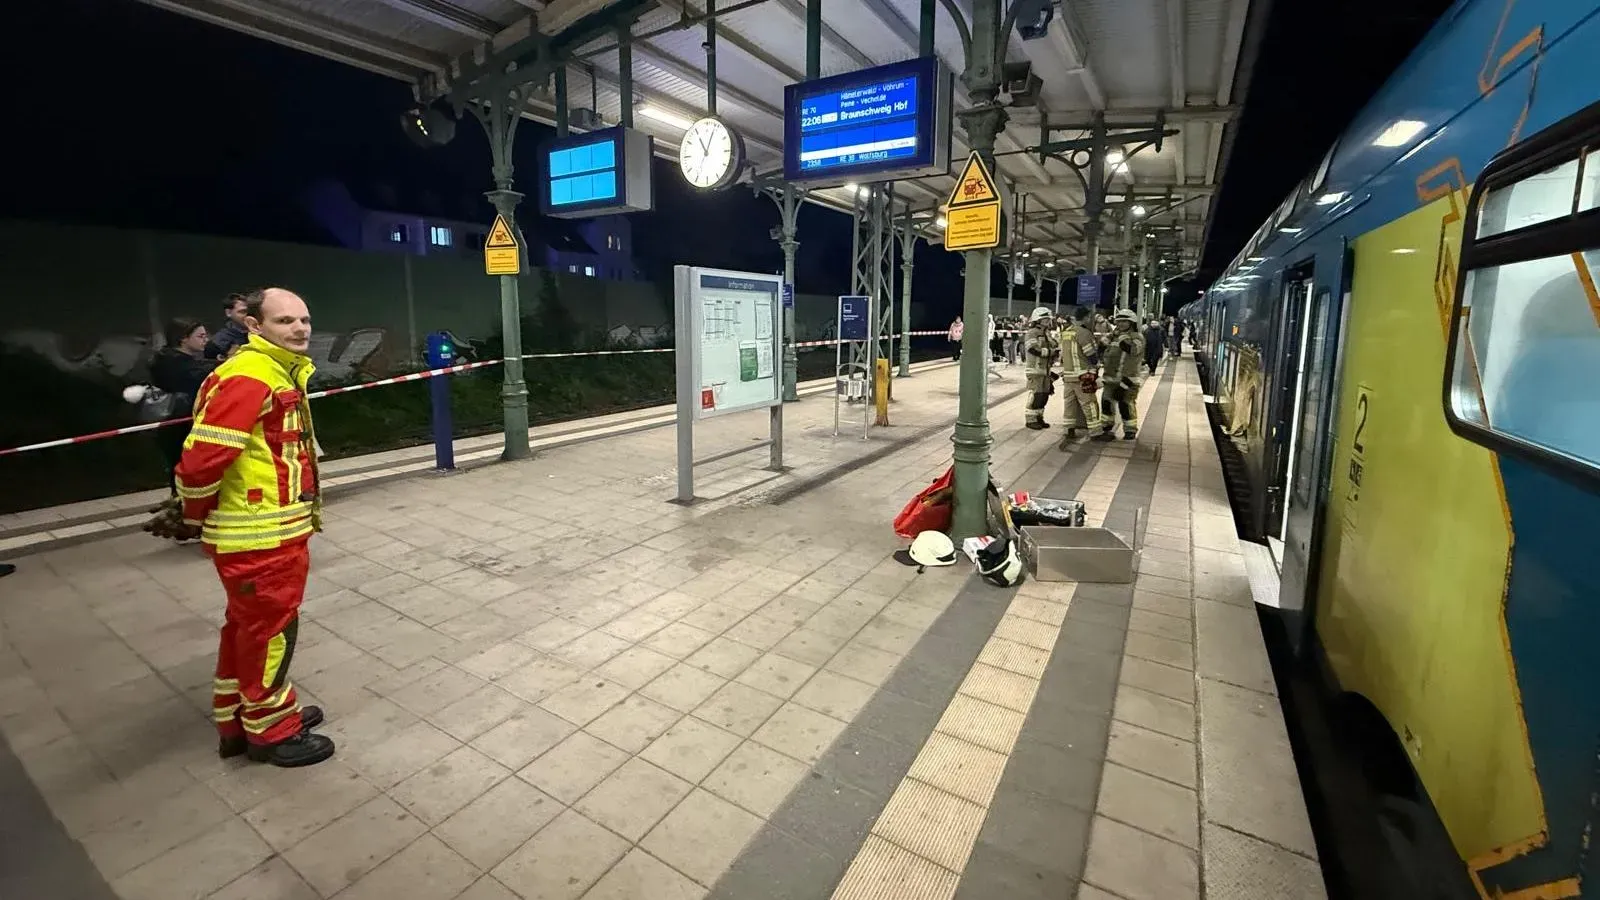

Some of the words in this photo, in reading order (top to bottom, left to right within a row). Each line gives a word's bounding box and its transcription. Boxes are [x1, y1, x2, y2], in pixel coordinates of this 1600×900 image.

[841, 100, 855, 109] Peine
[861, 94, 887, 104] Vechelde
[841, 104, 892, 120] Braunschweig
[894, 100, 908, 111] Hbf
[802, 115, 821, 127] 22:06
[859, 151, 888, 161] Wolfsburg
[1354, 393, 1368, 454] 2
